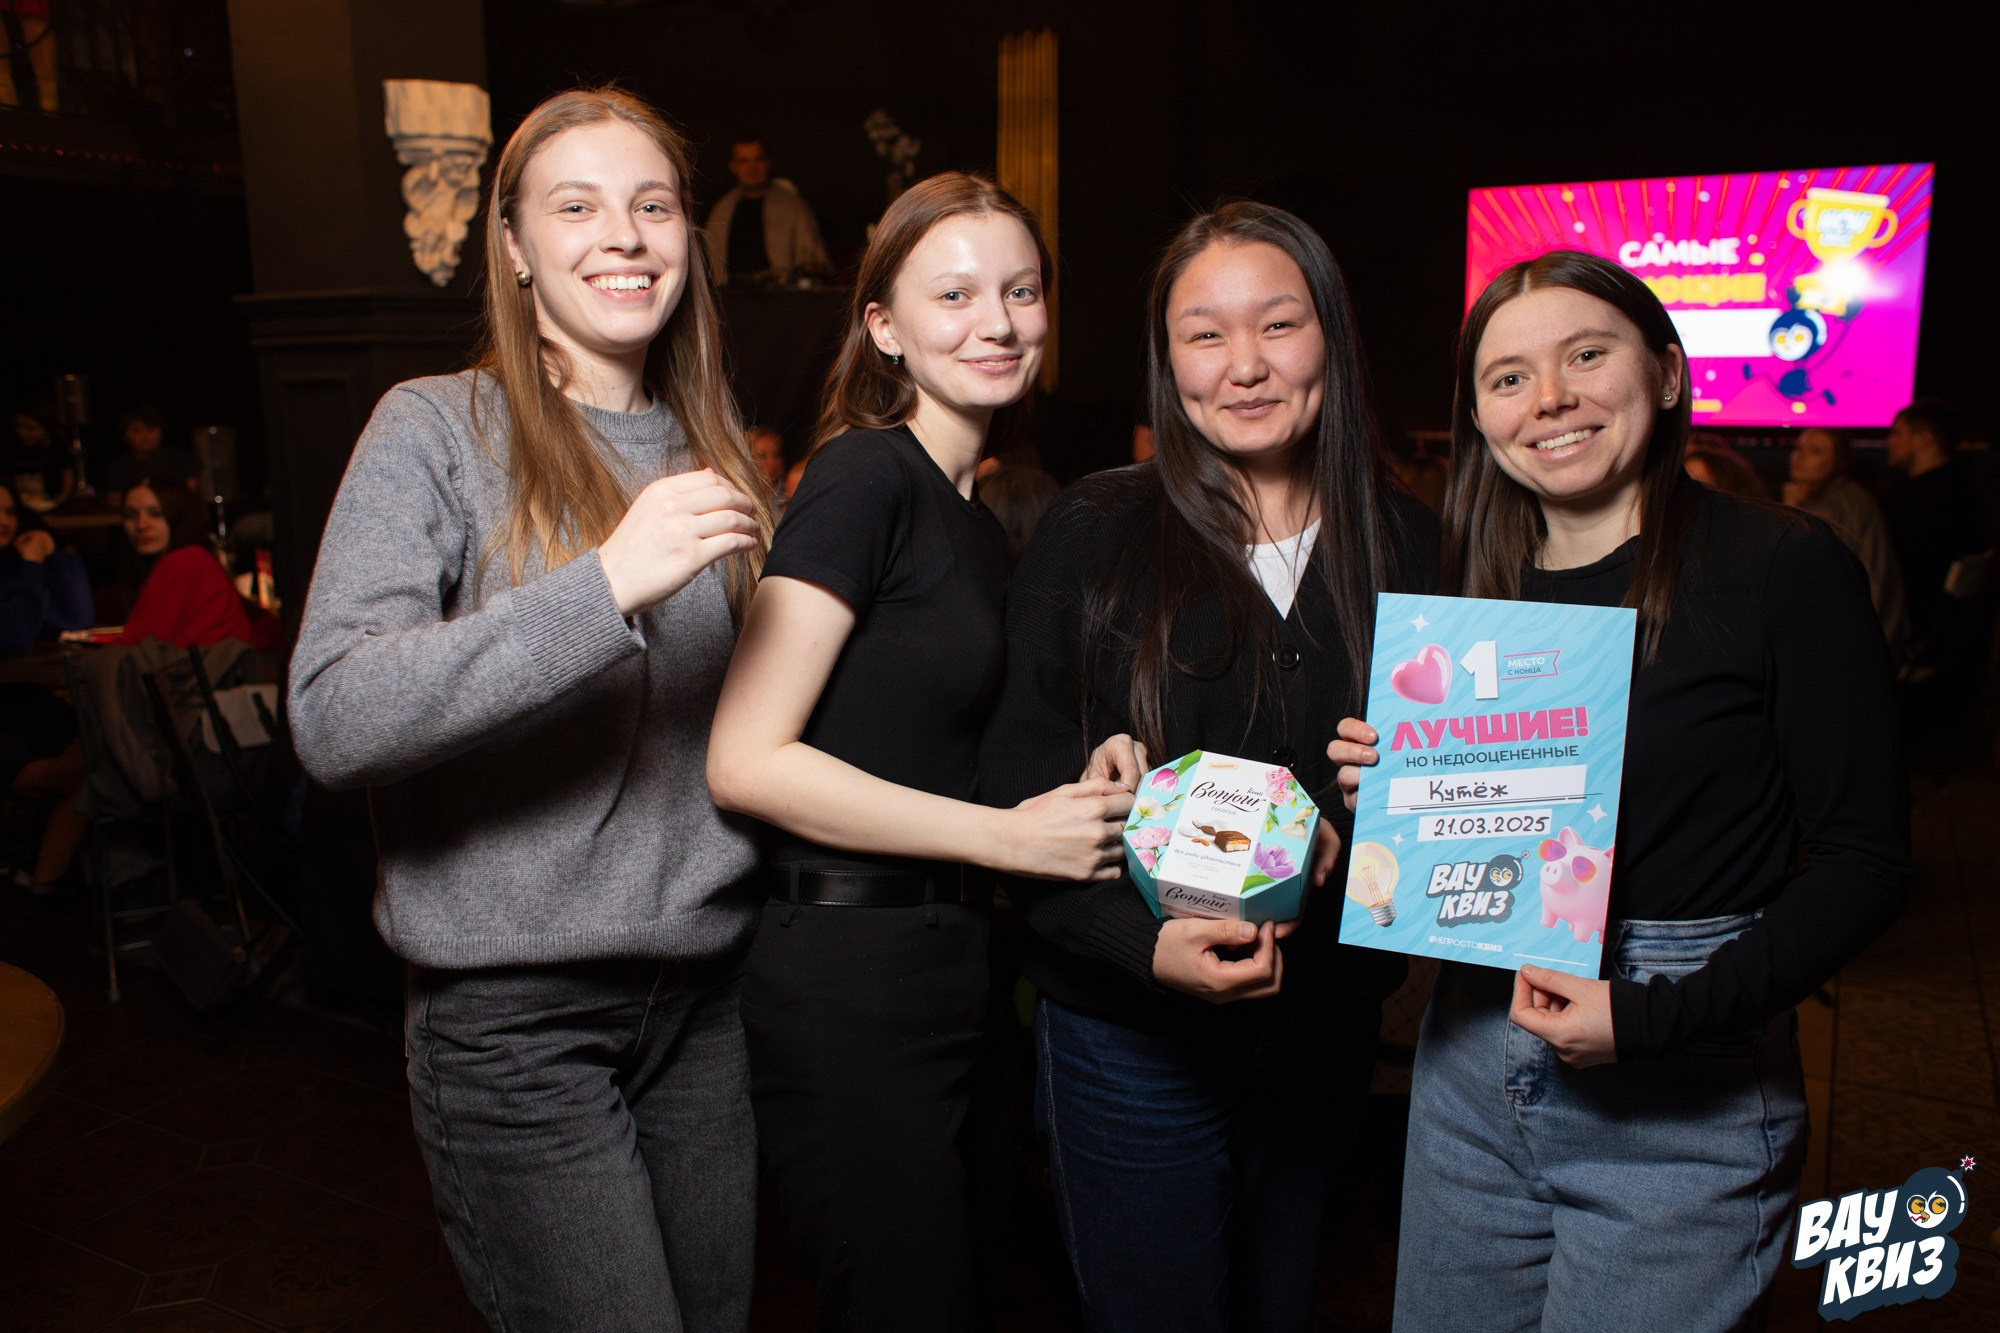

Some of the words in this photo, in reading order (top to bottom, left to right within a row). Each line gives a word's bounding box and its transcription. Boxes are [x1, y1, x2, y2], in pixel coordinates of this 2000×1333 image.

[1619, 238, 1741, 267] САМЫЕ
[1460, 640, 1499, 700] 1
[1507, 656, 1546, 668] МЕСТО
[1514, 667, 1542, 675] КОНЦА
[1390, 706, 1589, 751] ЛУЧШИЕ!
[1405, 755, 1428, 768] НО
[1433, 745, 1579, 767] НЕДООЦЕНЕННЫЕ
[1190, 781, 1267, 813] Bonjour
[1429, 780, 1509, 802] Кутёж
[1433, 815, 1550, 837] 21.03.2025
[1427, 861, 1487, 895] ВАУ
[1165, 886, 1231, 913] Bonjour
[1439, 891, 1507, 920] КВИЗ
[1428, 935, 1503, 953] #НЕПРОСТОКВИЗ
